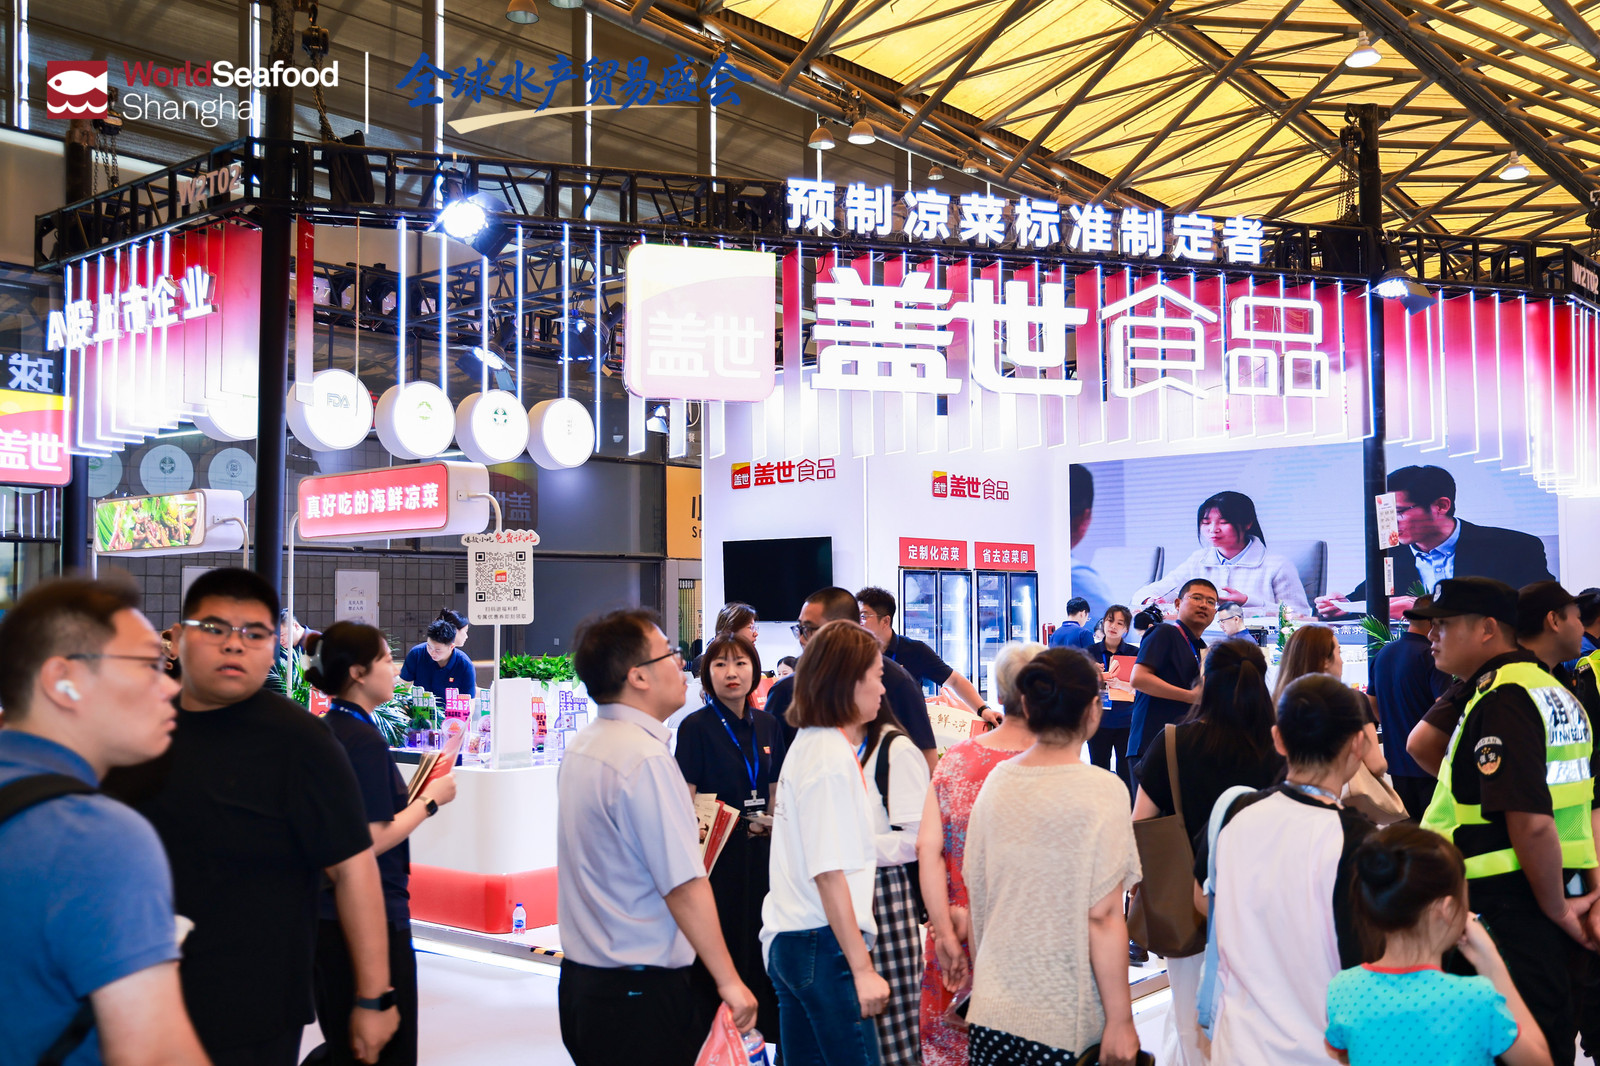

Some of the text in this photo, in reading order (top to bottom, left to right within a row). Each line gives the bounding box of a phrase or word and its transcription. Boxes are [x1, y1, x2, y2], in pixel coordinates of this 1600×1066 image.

[178, 163, 241, 206] W2T02
[786, 178, 1265, 264] 预制凉菜标准制定者
[1572, 260, 1599, 295] W2T02
[47, 265, 217, 351] A股上市企业
[646, 311, 765, 379] 盖世
[811, 266, 1330, 400] 盖世食品
[754, 459, 836, 486] 盖世食品
[950, 474, 1009, 500] 盖世食品
[306, 482, 439, 519] 真好吃的海鲜凉菜
[495, 532, 537, 544] 免费试吃
[908, 544, 960, 562] 定制化凉菜
[982, 548, 1029, 564] 省去凉菜间
